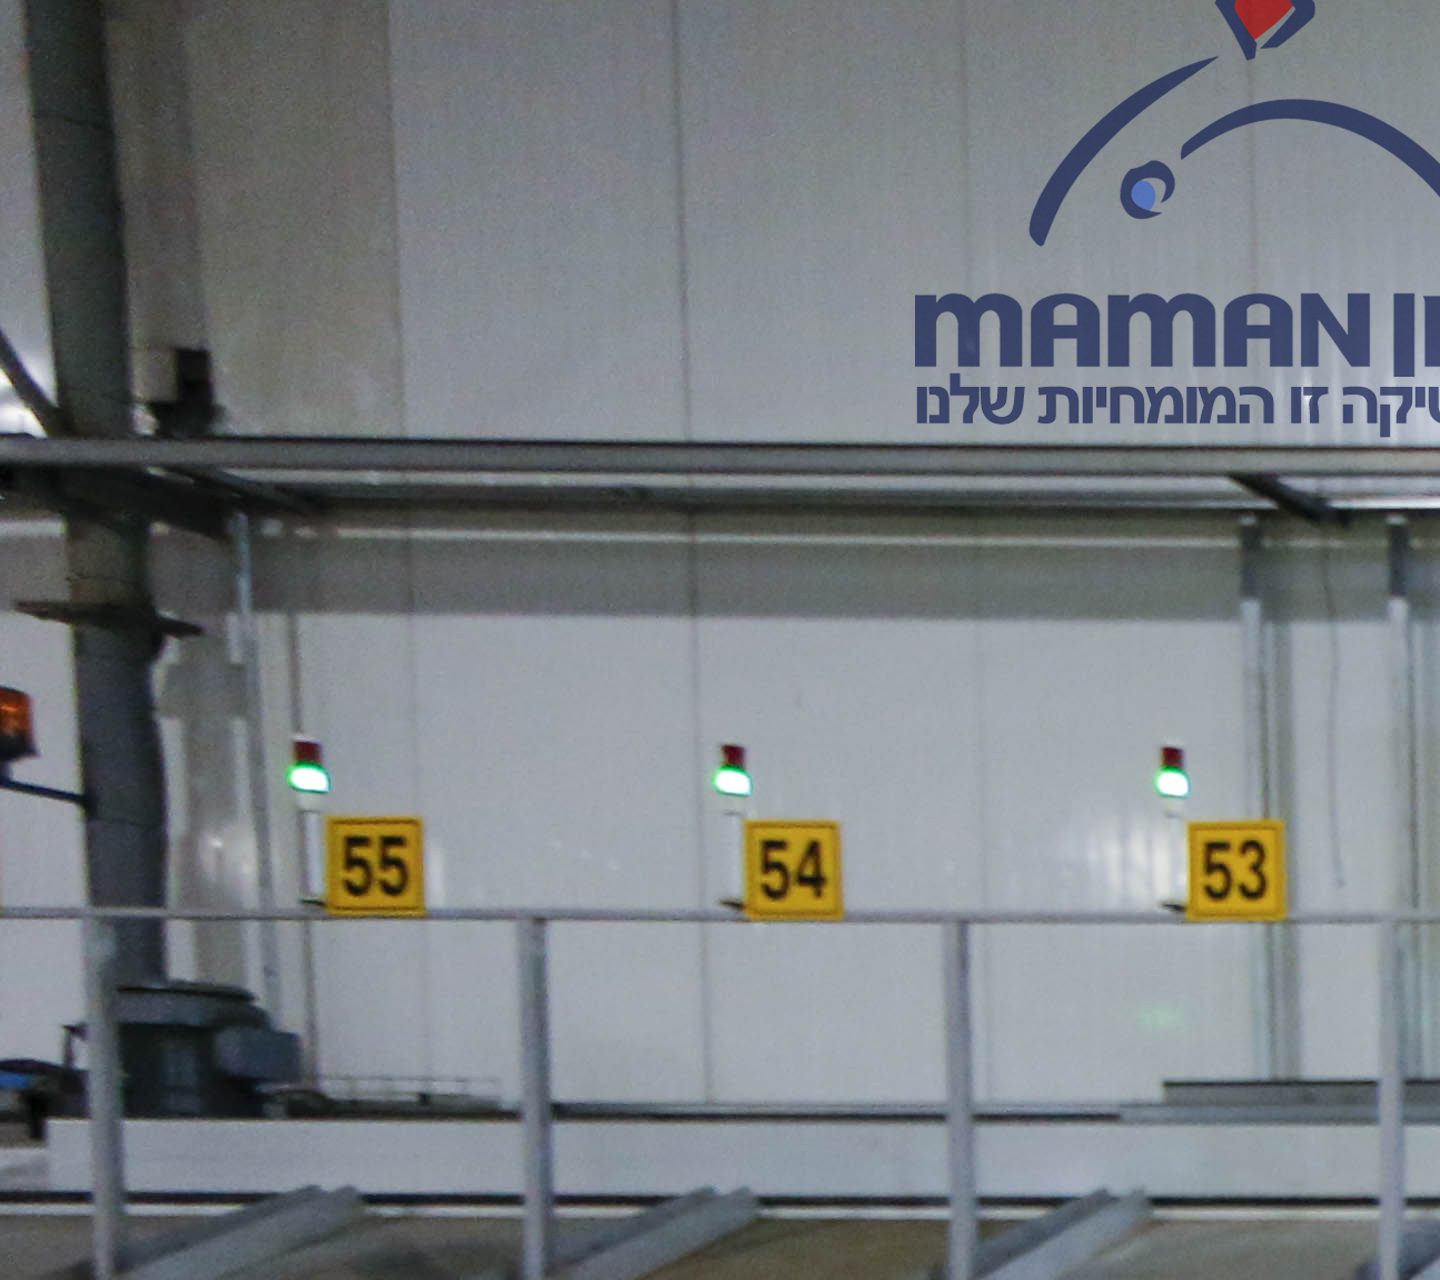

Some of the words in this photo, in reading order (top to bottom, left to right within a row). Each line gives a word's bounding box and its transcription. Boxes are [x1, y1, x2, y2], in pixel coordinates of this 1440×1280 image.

[914, 293, 1371, 368] MAMAN
[915, 373, 1025, 425] שלנו
[1038, 384, 1274, 425] המומחיות
[1290, 384, 1328, 425] זו
[341, 834, 410, 898] 55
[759, 838, 828, 902] 54
[1203, 839, 1268, 902] 53
